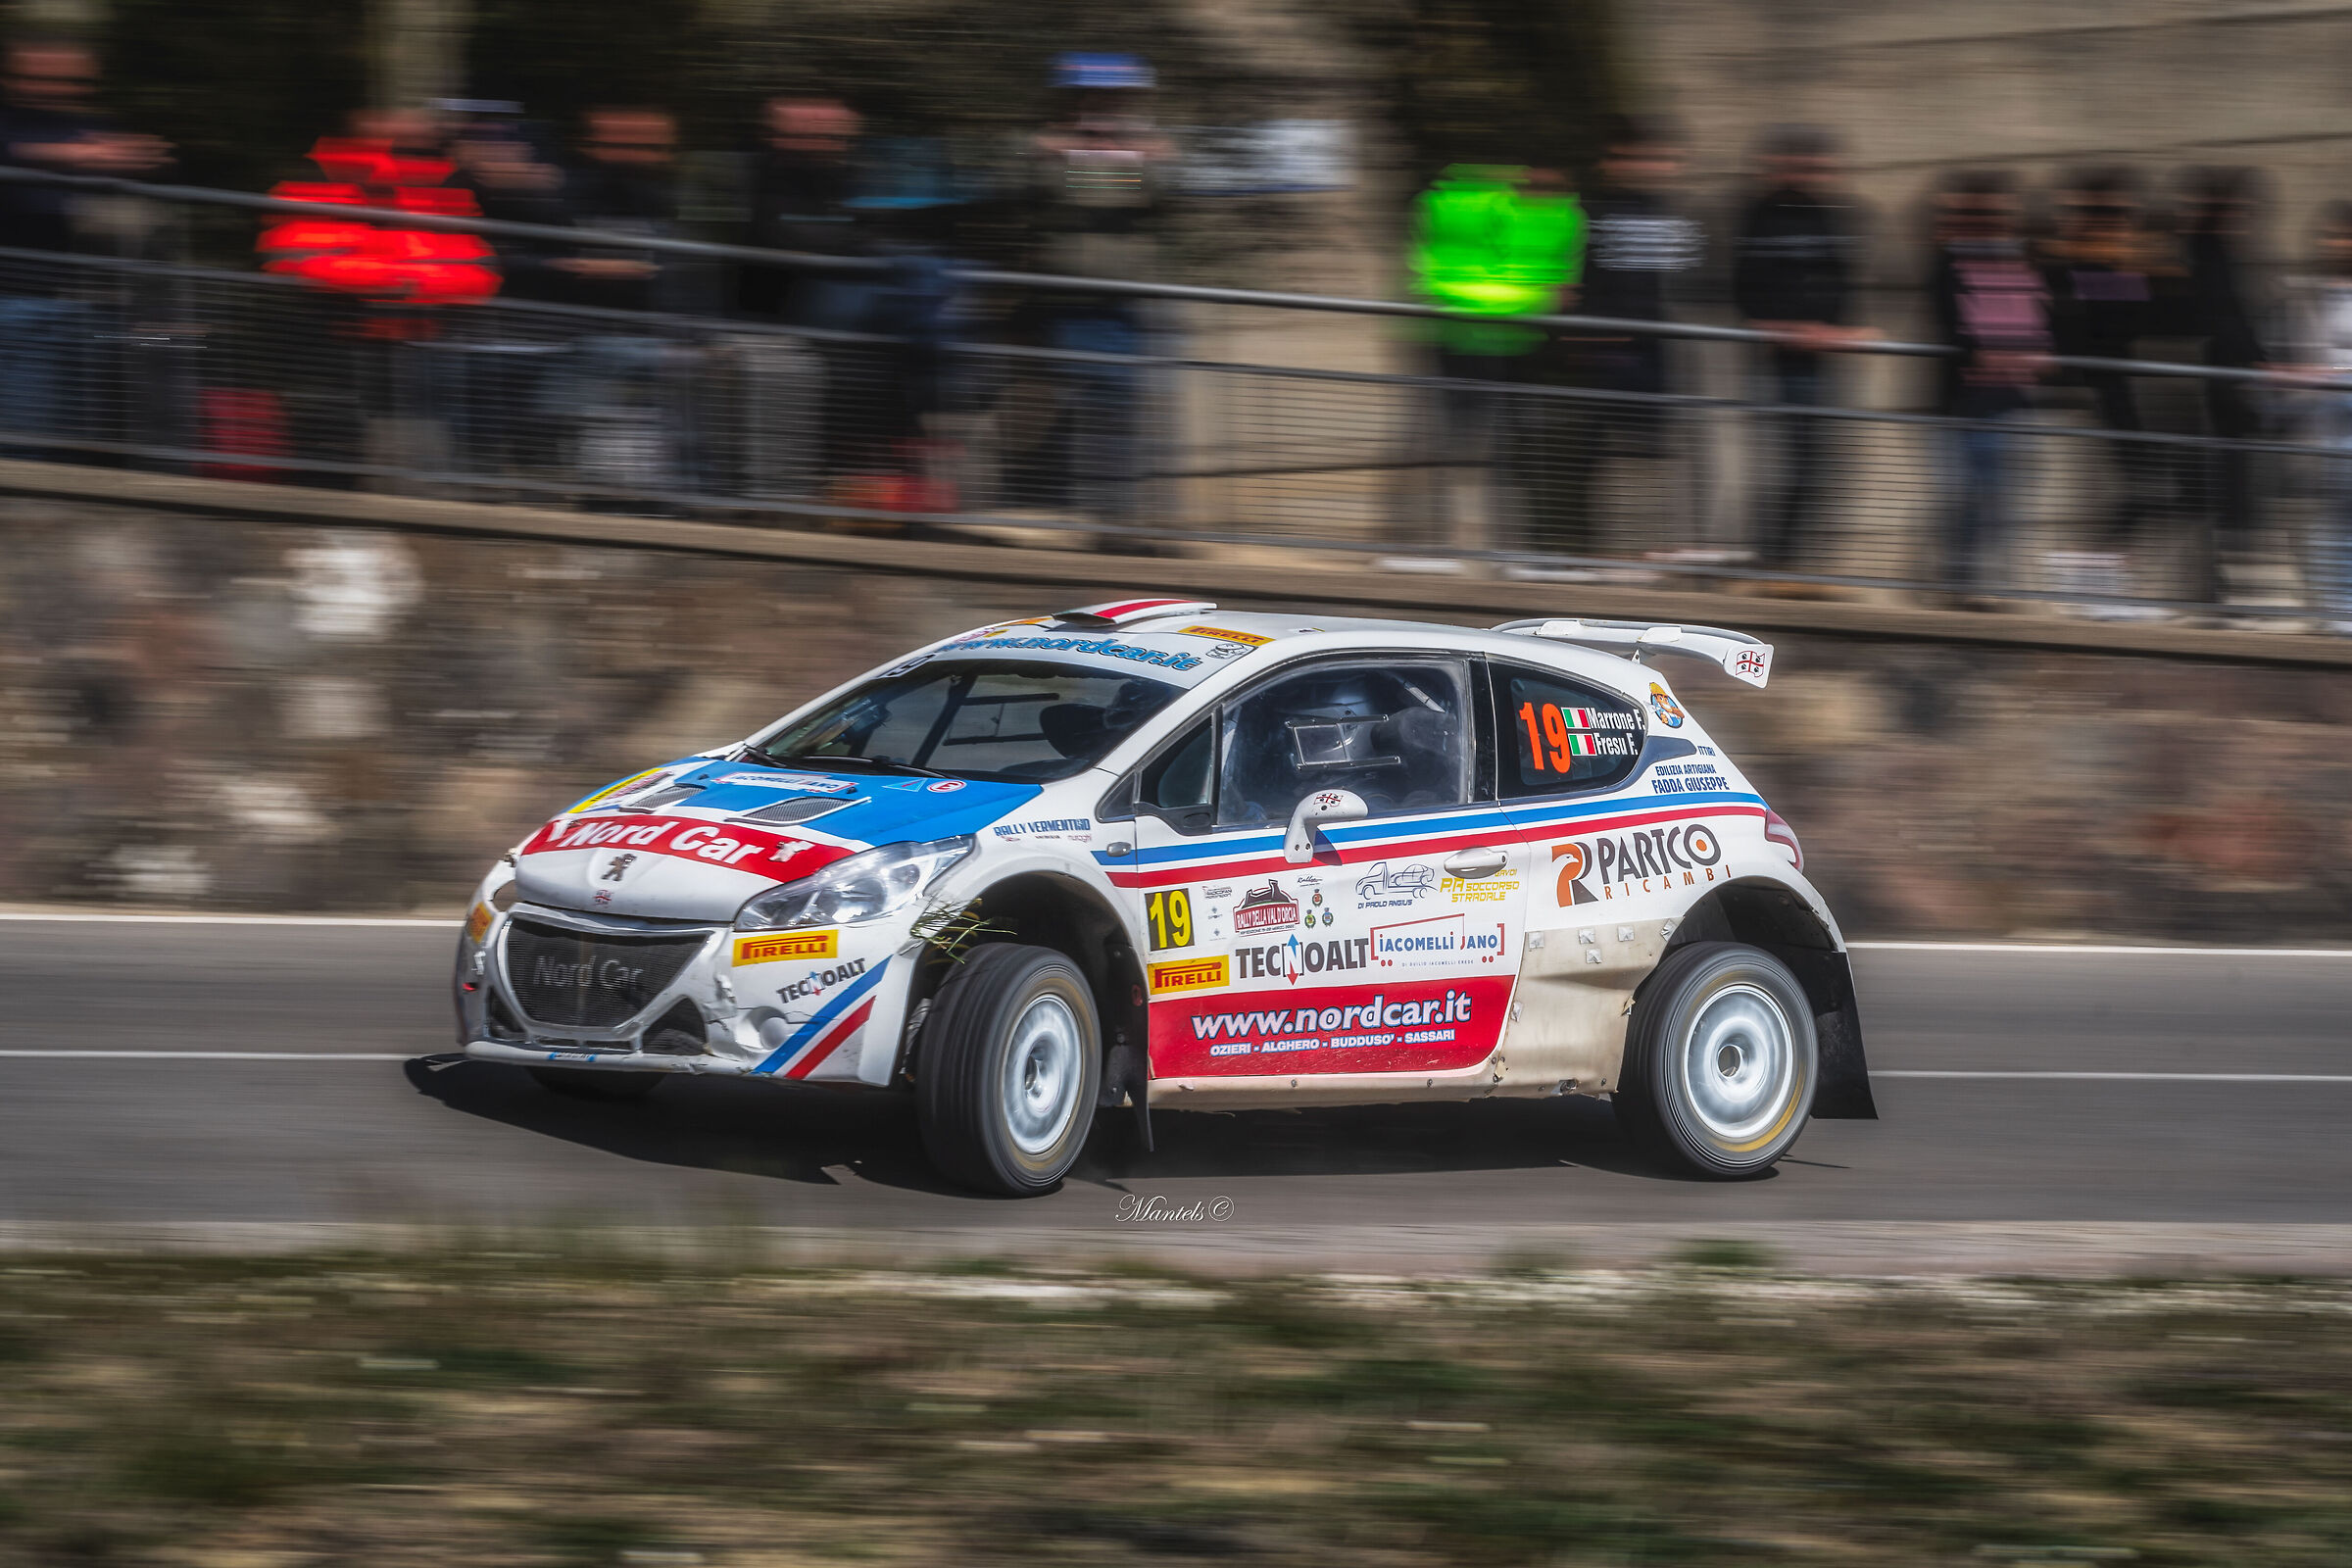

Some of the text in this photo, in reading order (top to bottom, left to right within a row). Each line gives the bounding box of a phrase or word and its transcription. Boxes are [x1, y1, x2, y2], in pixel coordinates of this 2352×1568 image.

[1189, 627, 1265, 643] PIRELLI
[935, 637, 1203, 671] www.nordcar.it
[1586, 708, 1645, 730] Marrone F.
[1519, 702, 1571, 773] 19
[1593, 733, 1639, 756] Fresu F.
[1655, 764, 1717, 776] EDILIZIA ARTIGIANA
[1651, 776, 1730, 794] FADDA GIUSEPPE
[557, 820, 764, 864] Nord Car
[993, 823, 1027, 836] RALLY
[1596, 824, 1721, 885] PARTCO
[1465, 881, 1520, 892] SOCCORSO
[1604, 864, 1733, 900] RICAMBI
[1388, 899, 1413, 907] ANGIUS
[1451, 892, 1506, 903] STRADALE
[1149, 890, 1192, 949] 19
[1236, 911, 1252, 928] RALLY
[742, 935, 828, 959] PIRELLI
[1236, 937, 1369, 980] TECNOALT
[534, 956, 644, 989] Nord Car
[1154, 962, 1222, 989] PIRELLI
[1191, 990, 1472, 1040] www.nordcar.it
[1210, 1043, 1251, 1057] OZIERI
[1260, 1038, 1320, 1054] ALGHERO
[1331, 1034, 1395, 1049] BUDDUSO'
[1404, 1029, 1455, 1045] SASSARI
